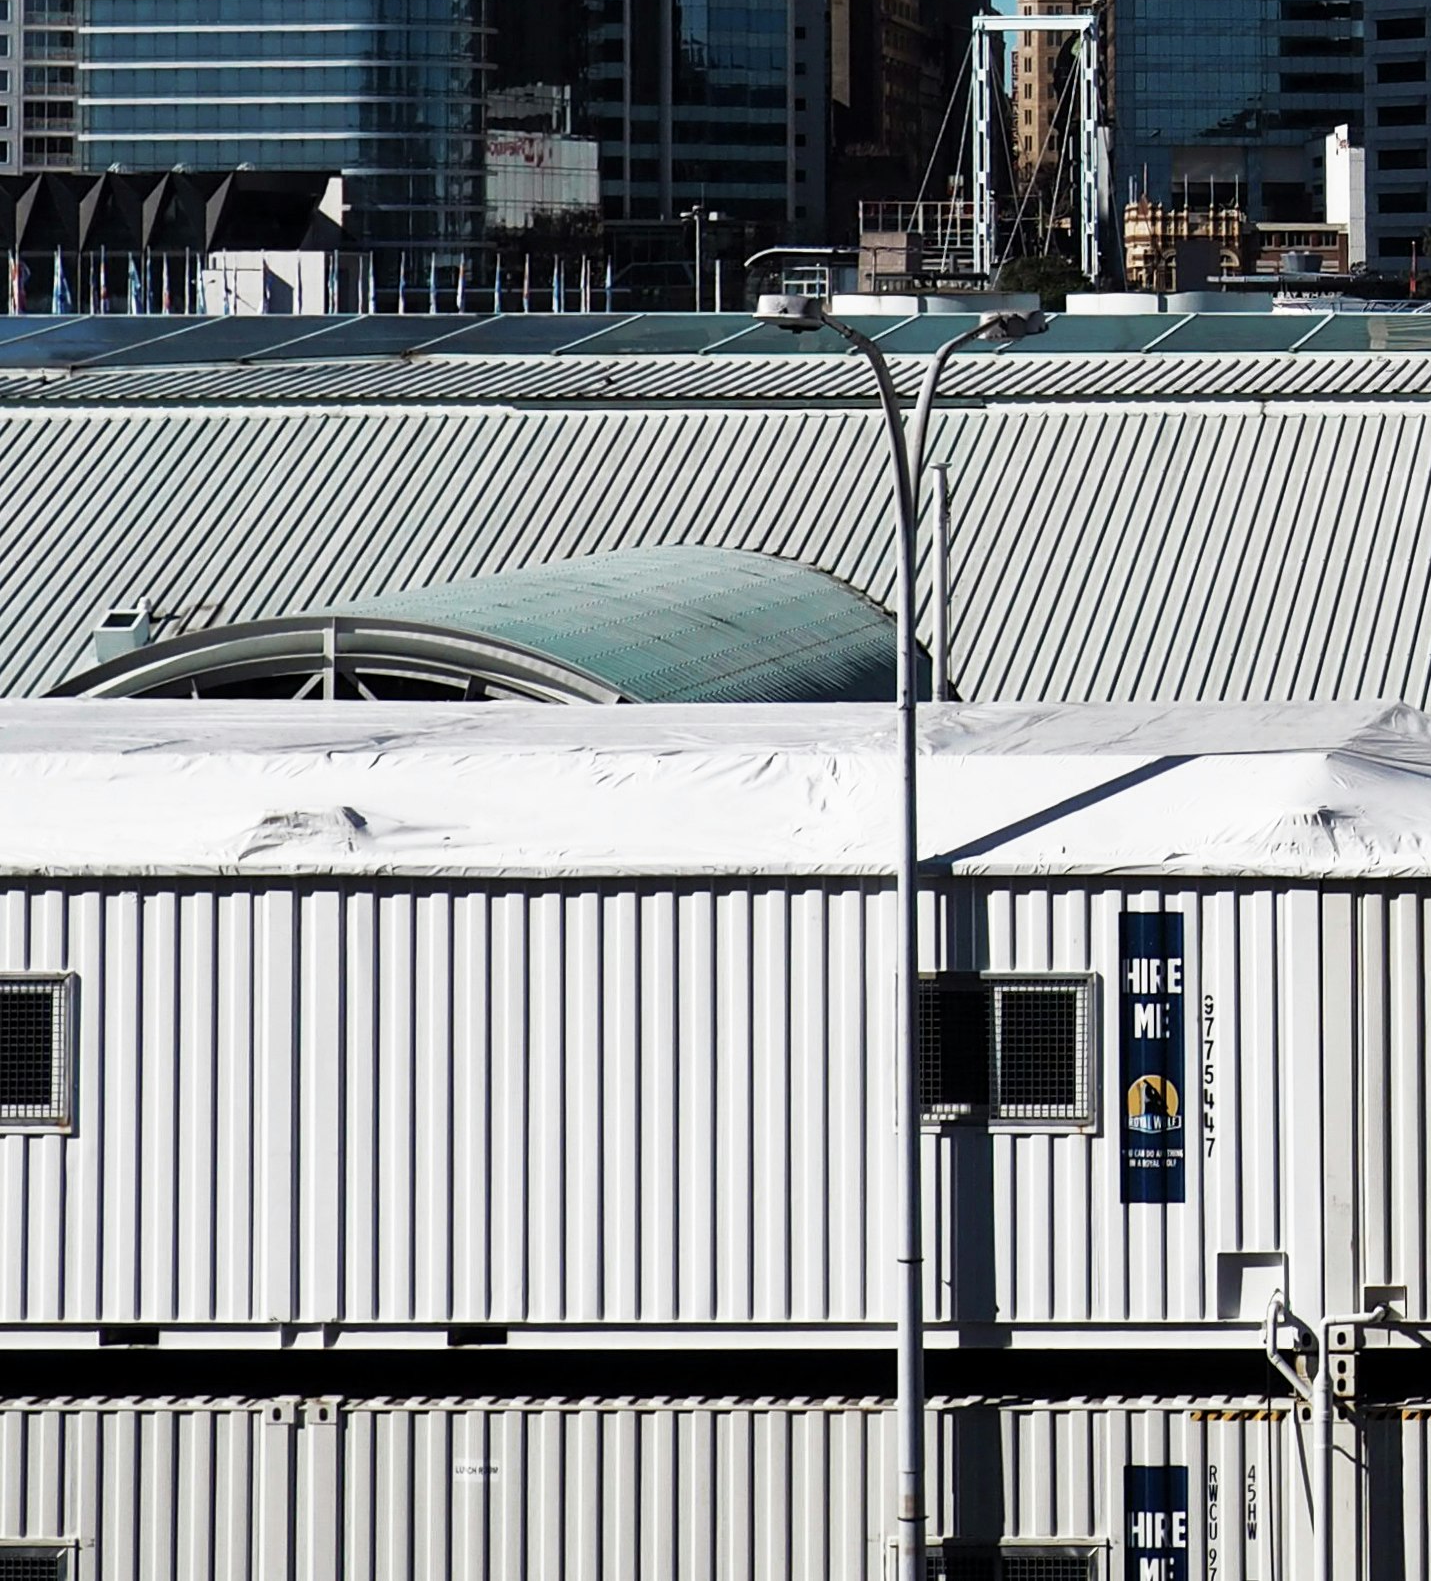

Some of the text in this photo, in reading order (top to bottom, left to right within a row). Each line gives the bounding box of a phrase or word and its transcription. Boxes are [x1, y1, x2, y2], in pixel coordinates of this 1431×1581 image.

[1122, 958, 1182, 994] HIRE
[1127, 1511, 1186, 1548] HIRE
[1208, 1465, 1218, 1540] RWCU
[1247, 1465, 1257, 1540] 45HW
